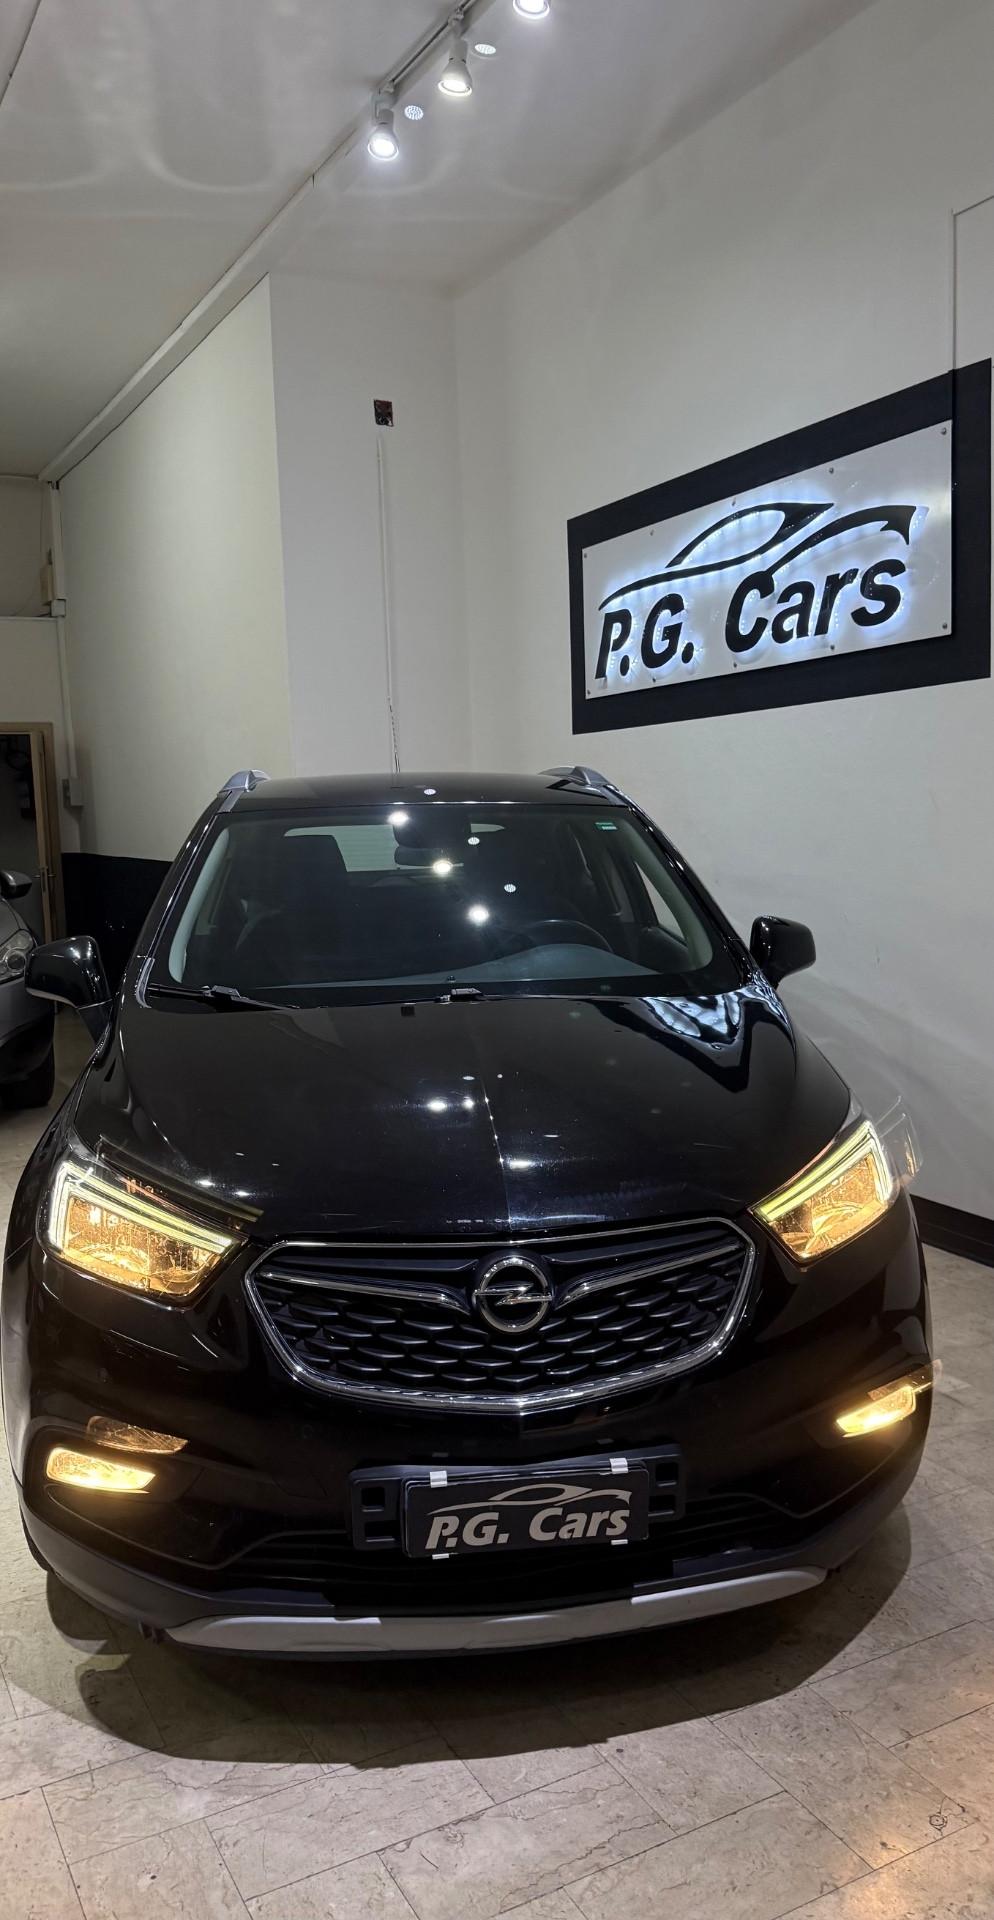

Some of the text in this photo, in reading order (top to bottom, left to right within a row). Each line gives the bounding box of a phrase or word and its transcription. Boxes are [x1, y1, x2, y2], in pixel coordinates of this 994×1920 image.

[595, 558, 907, 680] P.G. Cars
[425, 1507, 630, 1550] P.G. Cars
